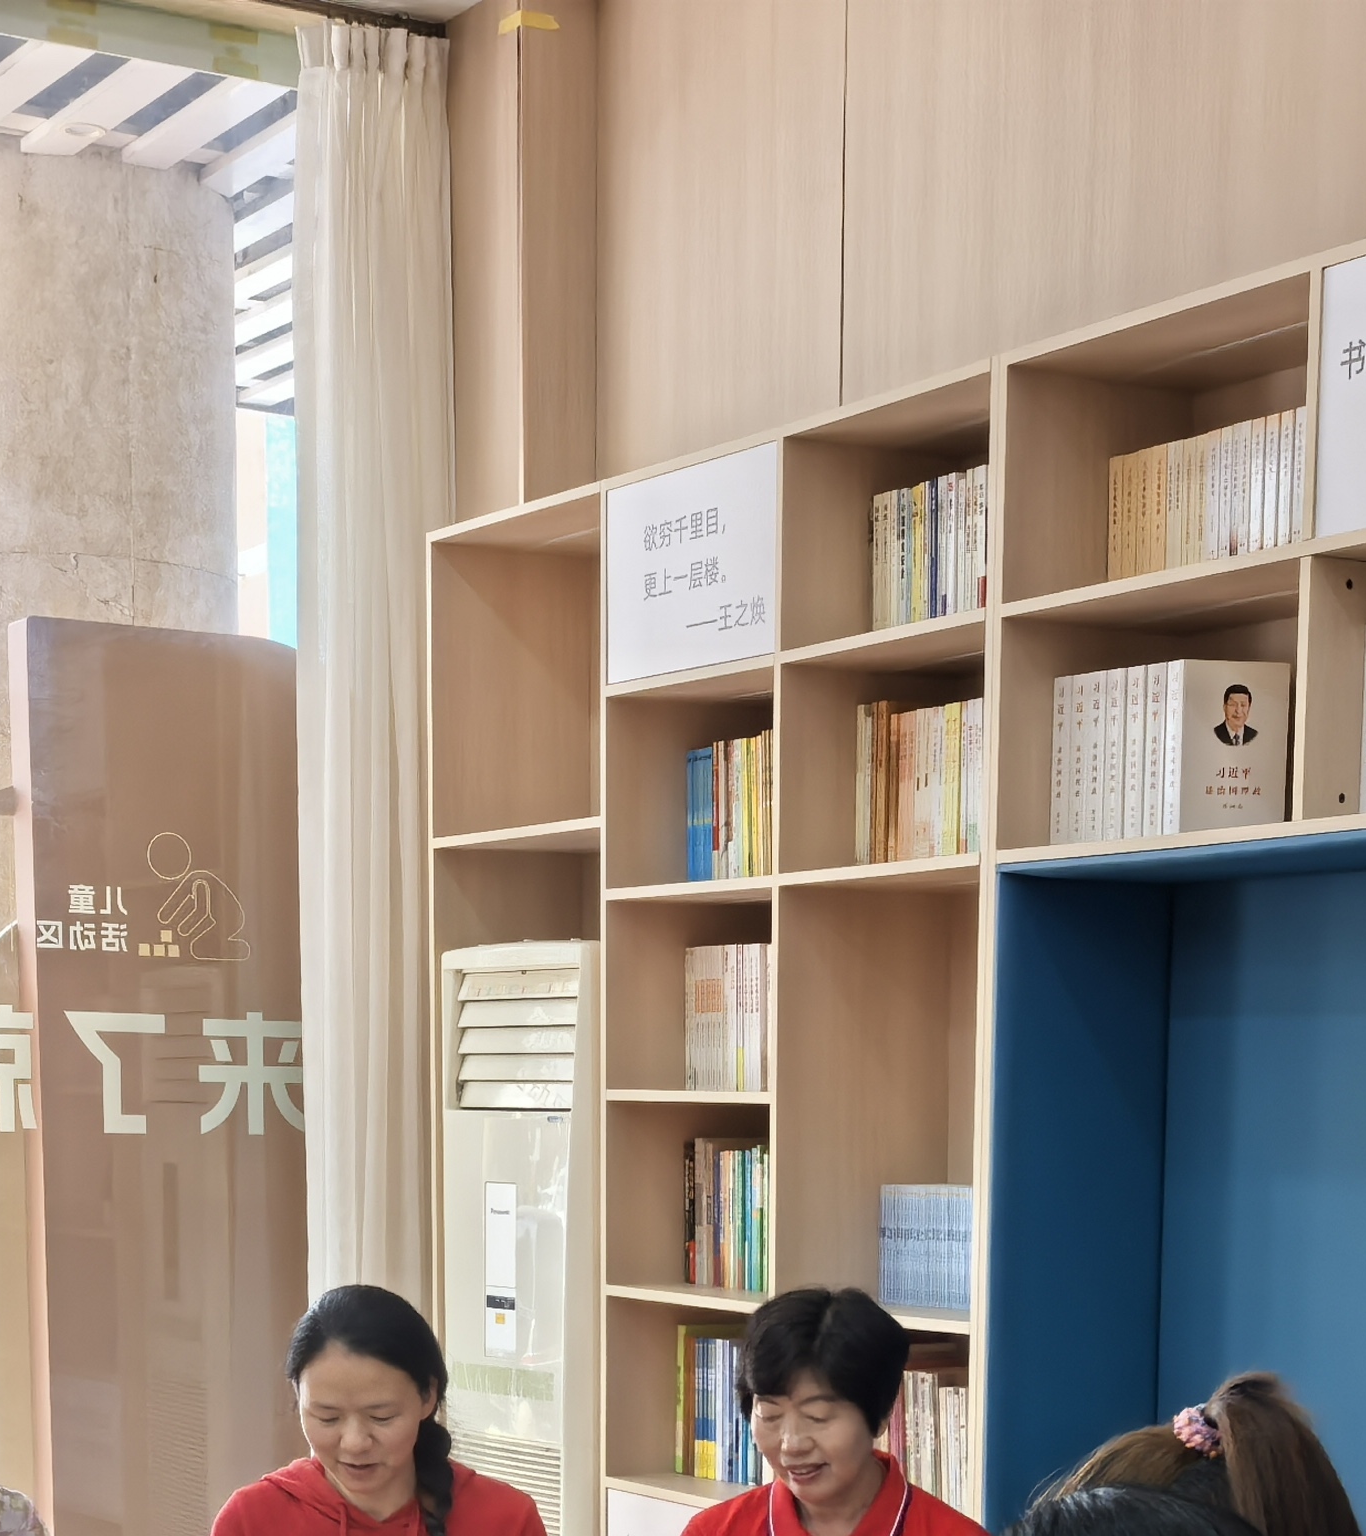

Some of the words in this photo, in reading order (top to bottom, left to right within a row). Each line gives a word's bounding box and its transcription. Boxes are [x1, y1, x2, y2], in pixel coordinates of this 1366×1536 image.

[643, 507, 726, 551] 欲穷千里目，
[643, 556, 727, 600] 更上一层楼。
[1216, 767, 1251, 780] 习近平
